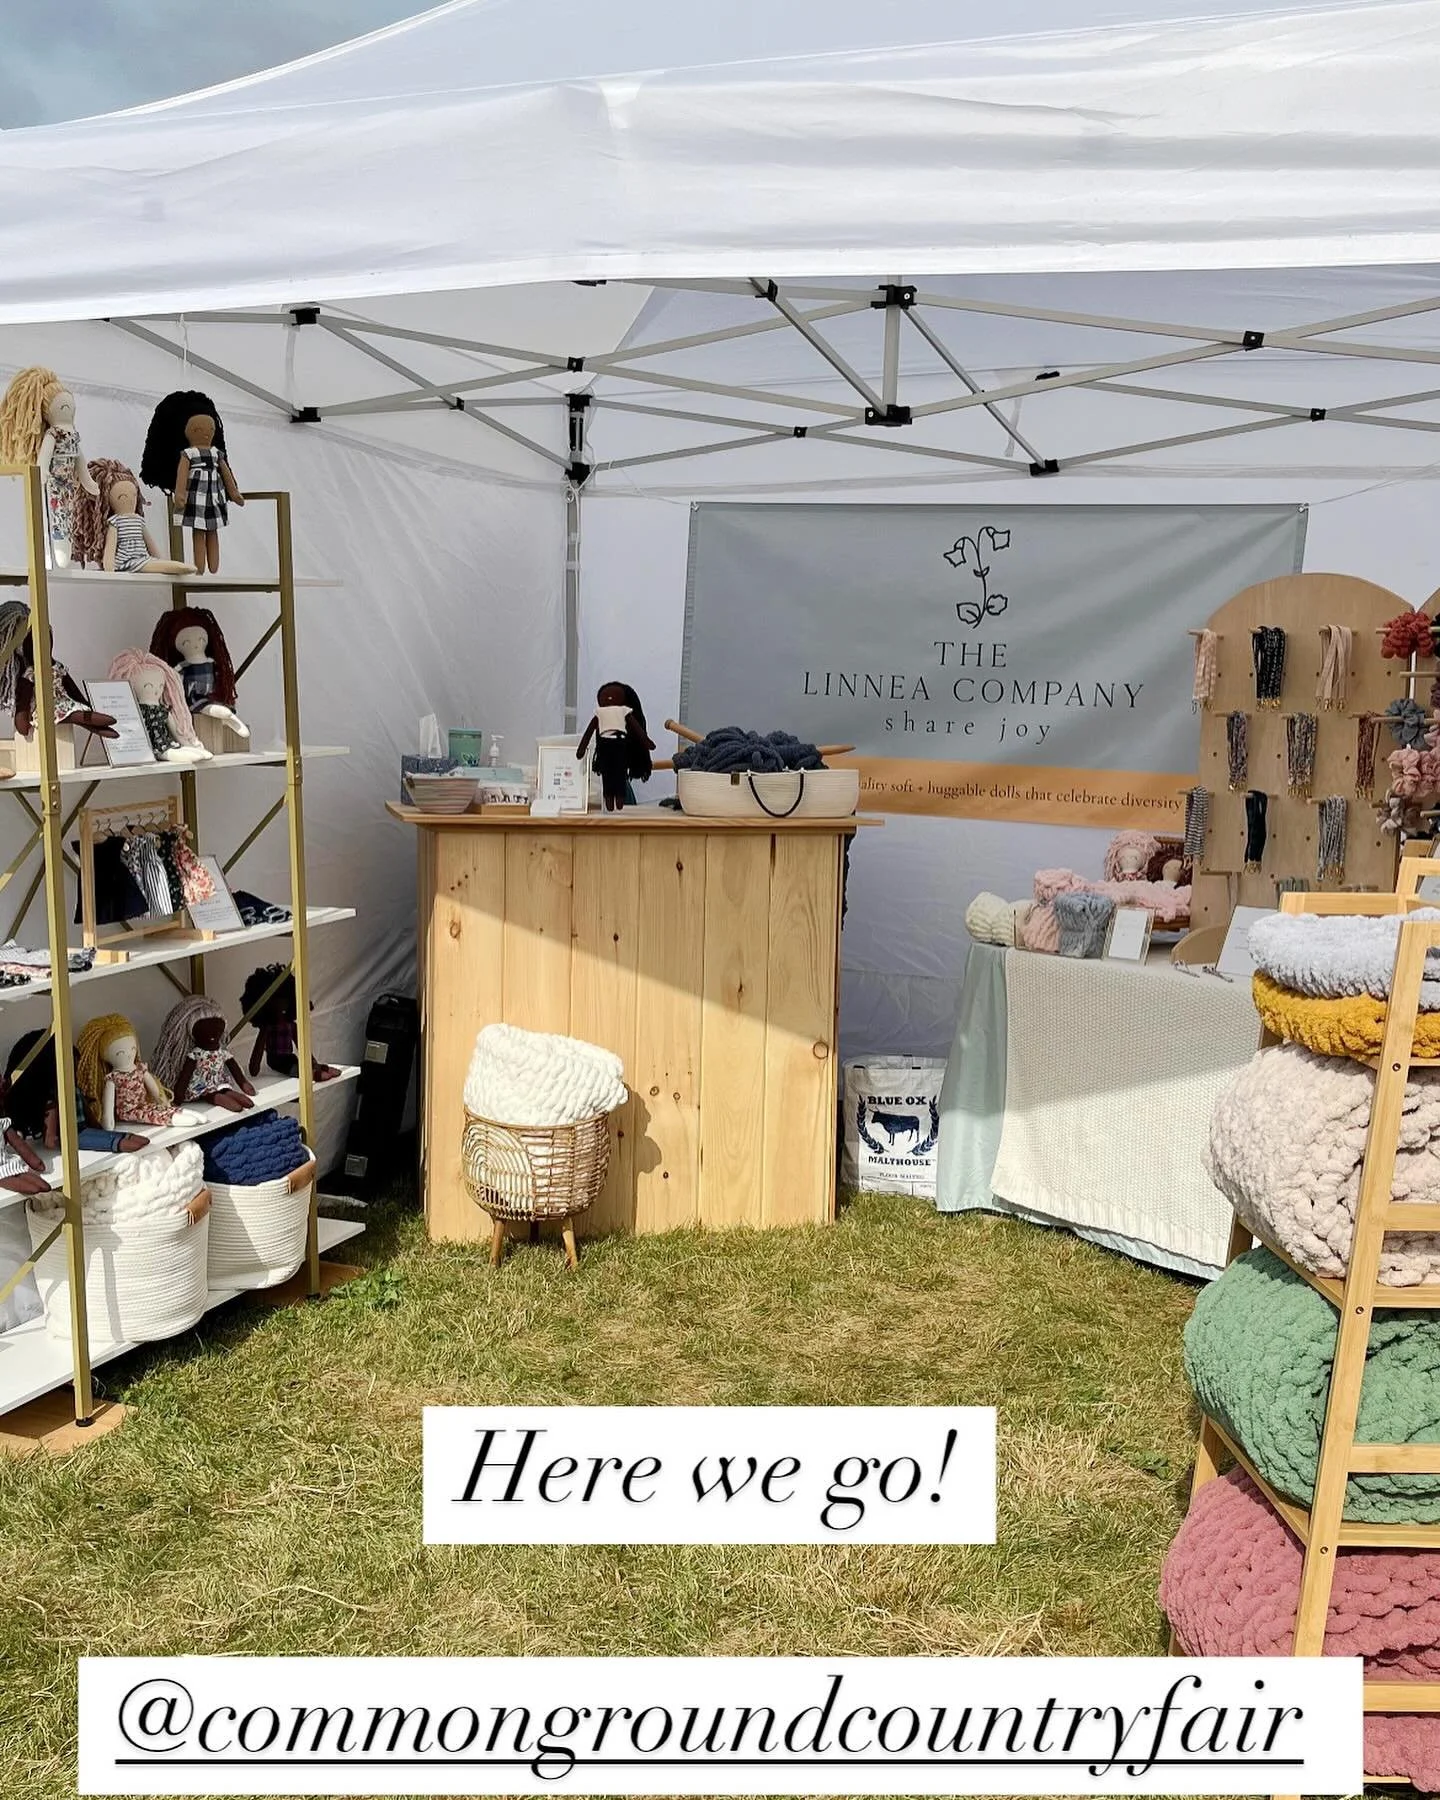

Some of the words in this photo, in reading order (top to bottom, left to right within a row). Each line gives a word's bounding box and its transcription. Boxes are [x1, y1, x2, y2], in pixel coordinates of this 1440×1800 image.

[933, 641, 1008, 668] THE
[804, 671, 930, 701] LINNEA
[952, 677, 1145, 709] COMPANY
[885, 710, 975, 735] share
[999, 716, 1051, 745] joy
[890, 779, 913, 793] soft
[927, 780, 986, 799] huggable
[989, 783, 1021, 799] dolls
[1025, 786, 1052, 801] that
[1056, 788, 1118, 807] celebrate
[1121, 791, 1183, 814] diversity
[867, 1095, 903, 1106] BLUE
[905, 1095, 928, 1106] OX
[868, 1155, 931, 1166] MALTHOUSE
